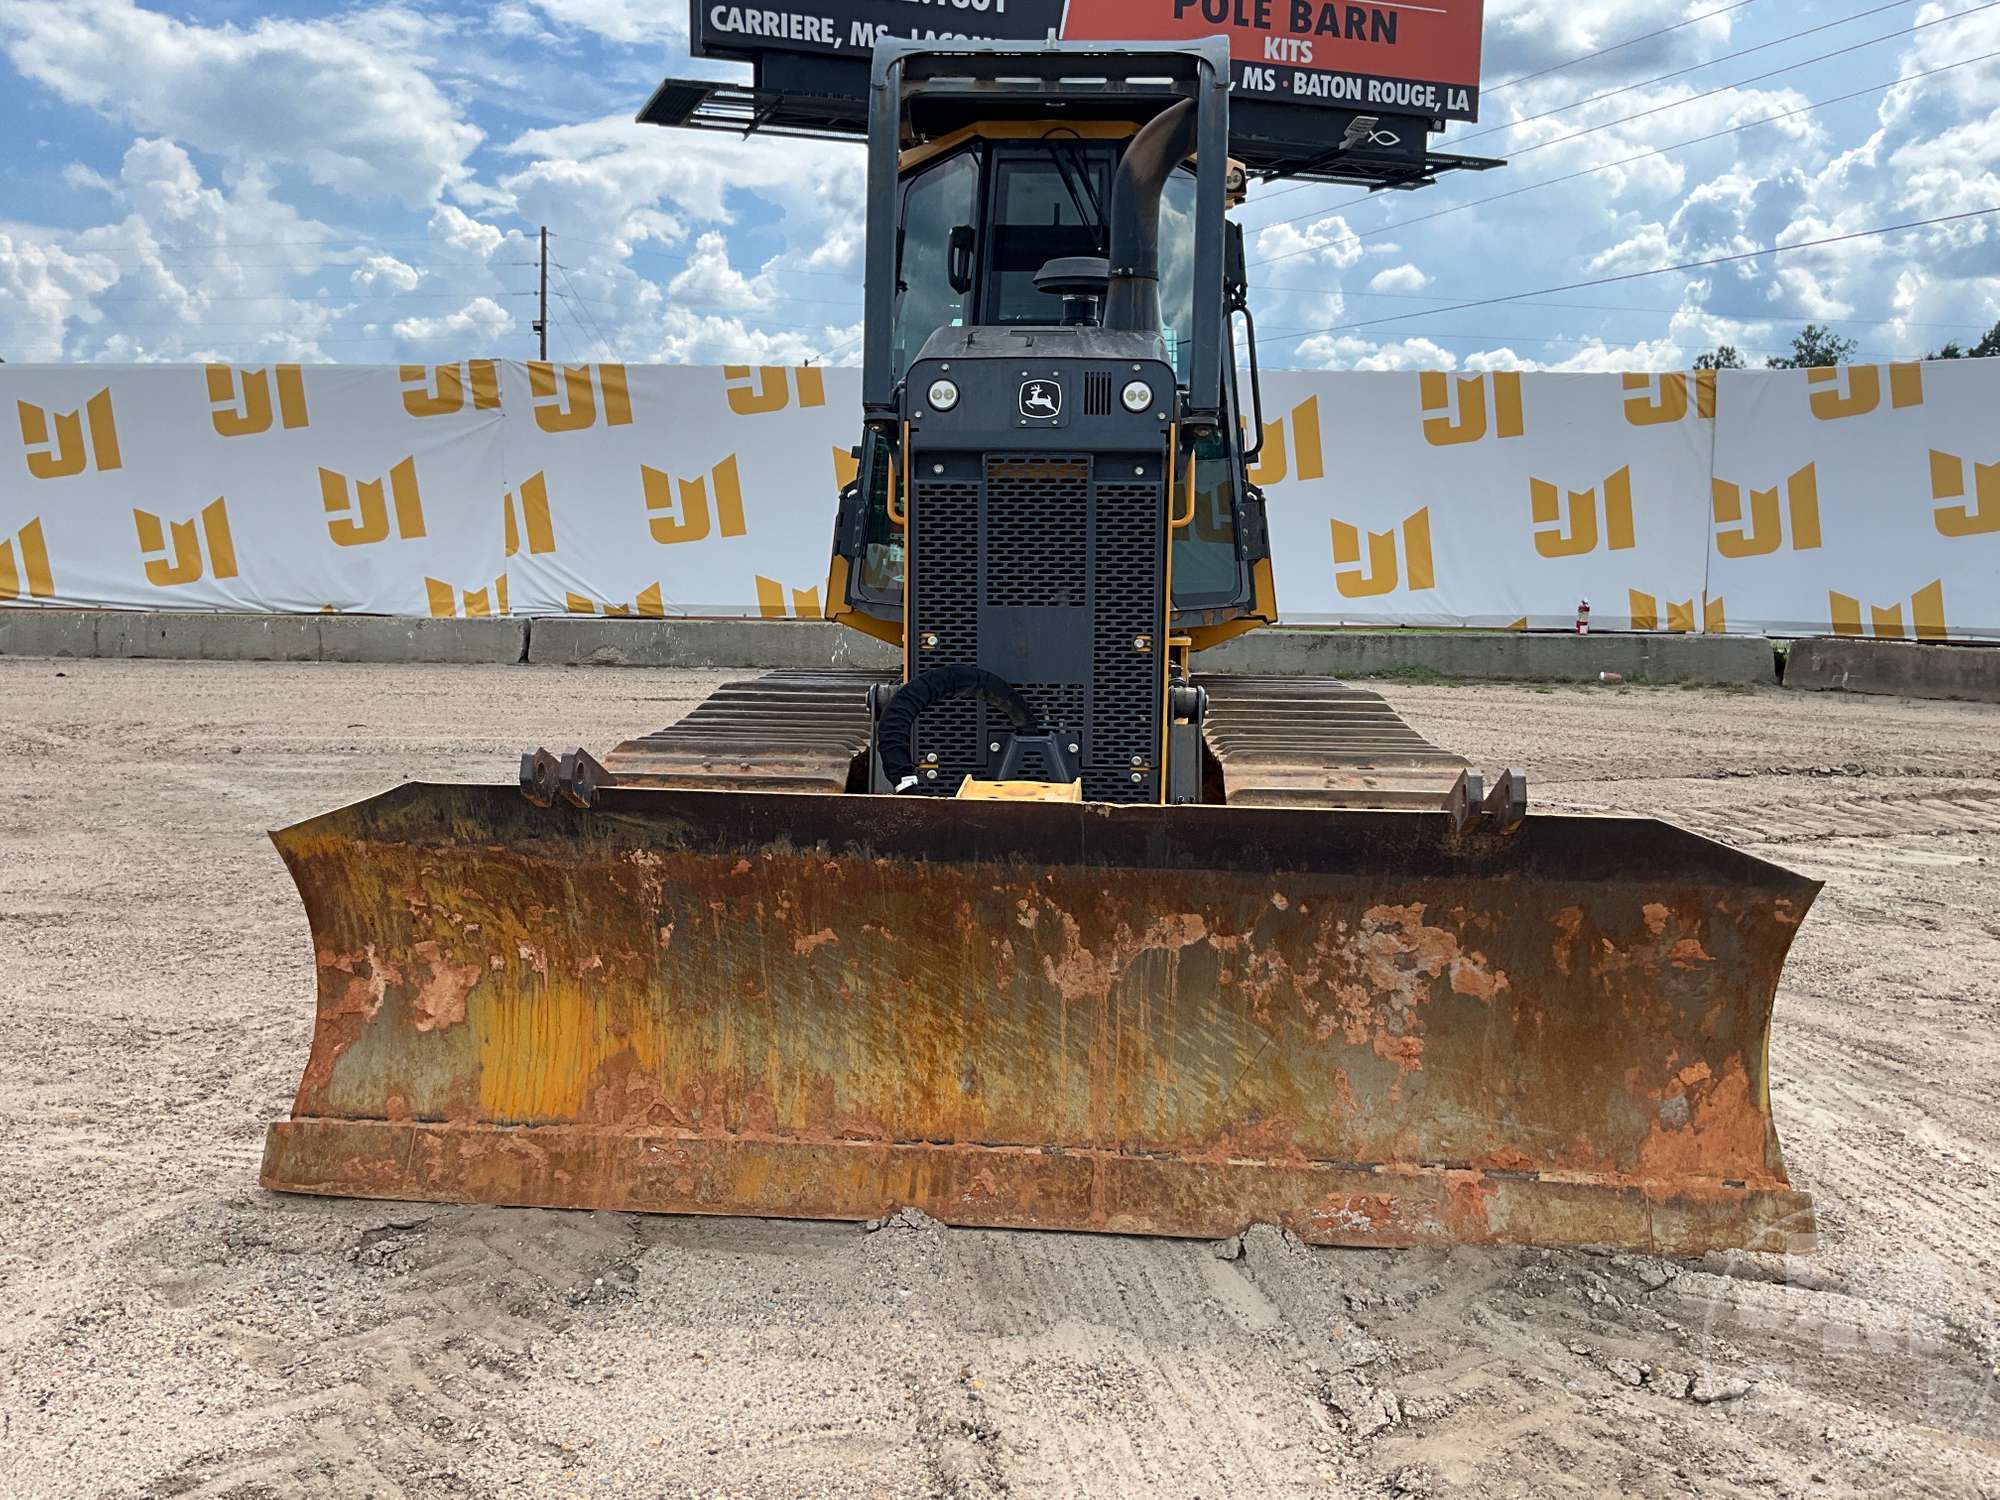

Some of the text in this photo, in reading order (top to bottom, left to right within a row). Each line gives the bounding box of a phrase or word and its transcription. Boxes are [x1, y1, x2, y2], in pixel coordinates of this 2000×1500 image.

[710, 5, 843, 49] CARRIERE,
[1173, 0, 1398, 45] POLE BARN
[1264, 36, 1313, 64] KITS
[1241, 66, 1276, 92] MS
[1293, 72, 1362, 100] BATON
[1368, 80, 1441, 112] ROUGE,
[1447, 88, 1470, 111] LA
